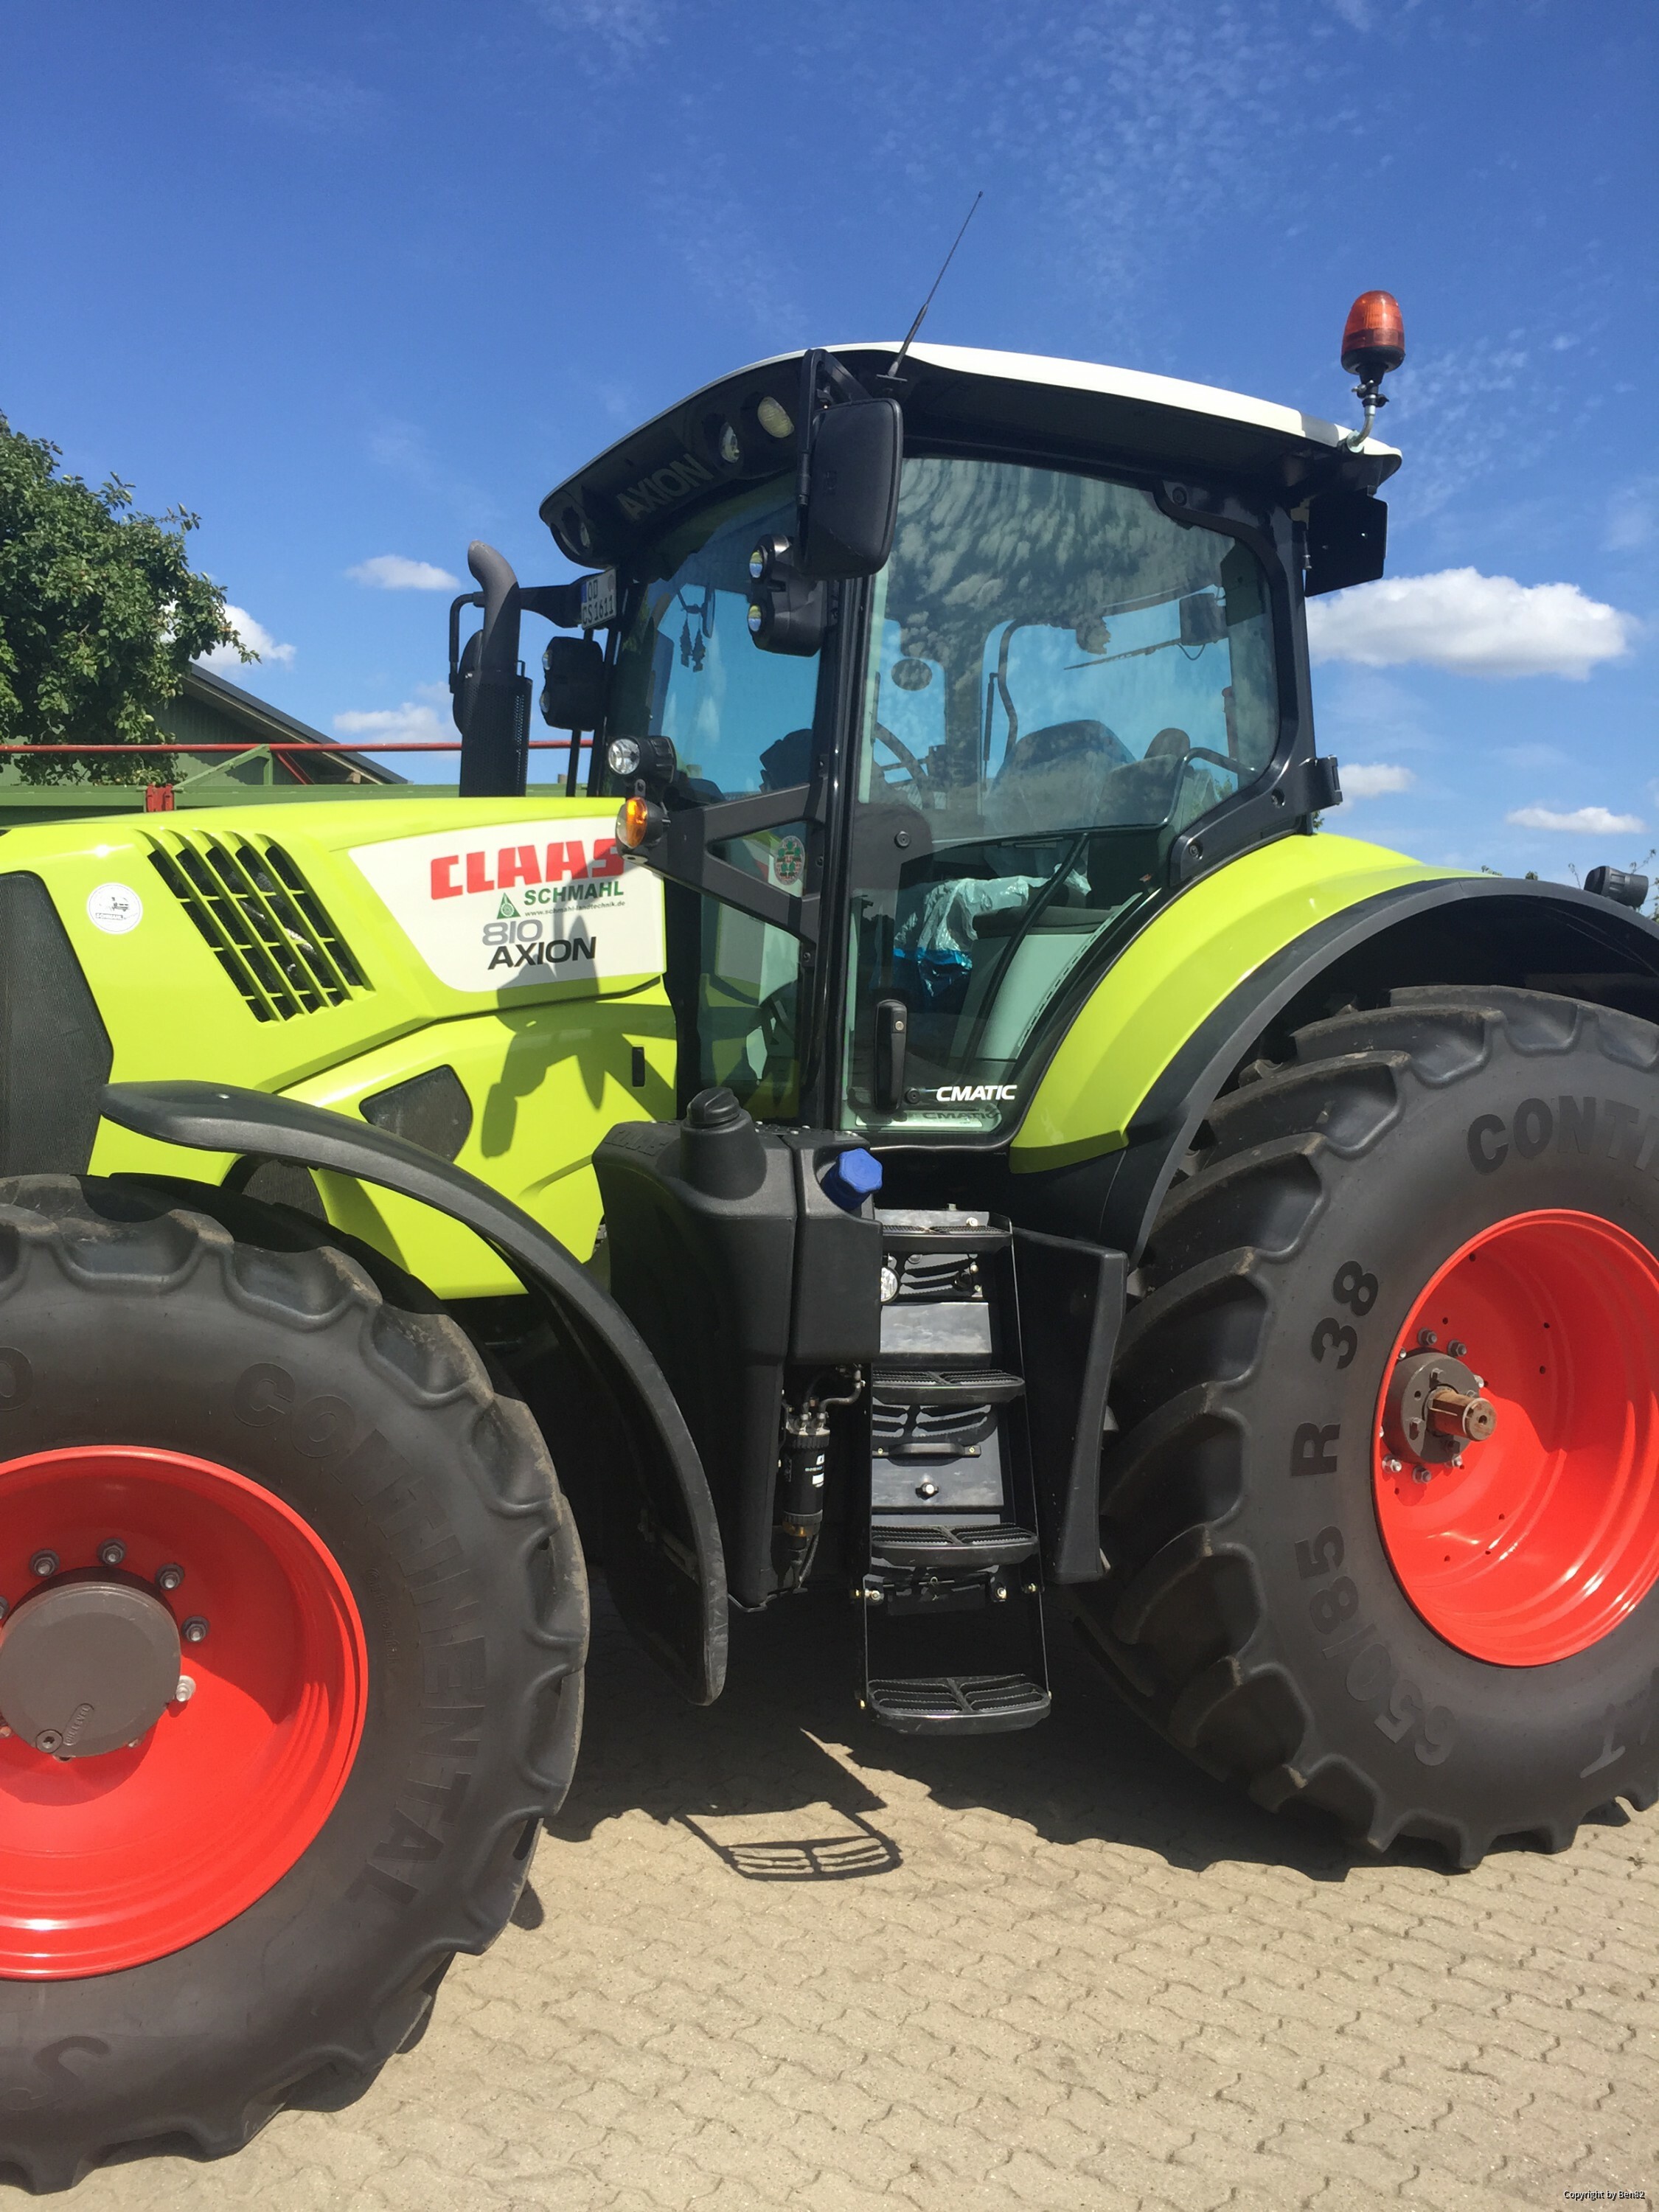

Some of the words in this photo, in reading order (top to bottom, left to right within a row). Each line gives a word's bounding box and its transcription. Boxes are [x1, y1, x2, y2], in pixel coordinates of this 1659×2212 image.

[615, 452, 714, 522] AXION
[431, 838, 625, 900] CLAAS
[524, 880, 625, 906] SCHMAHL
[524, 900, 626, 917] www.schmahl-landtechnik.de
[482, 919, 543, 946] 810
[487, 936, 597, 970] AXION
[936, 1085, 1018, 1102] CMATIC
[1310, 1259, 1379, 1370] 38
[1291, 1421, 1340, 1476] R
